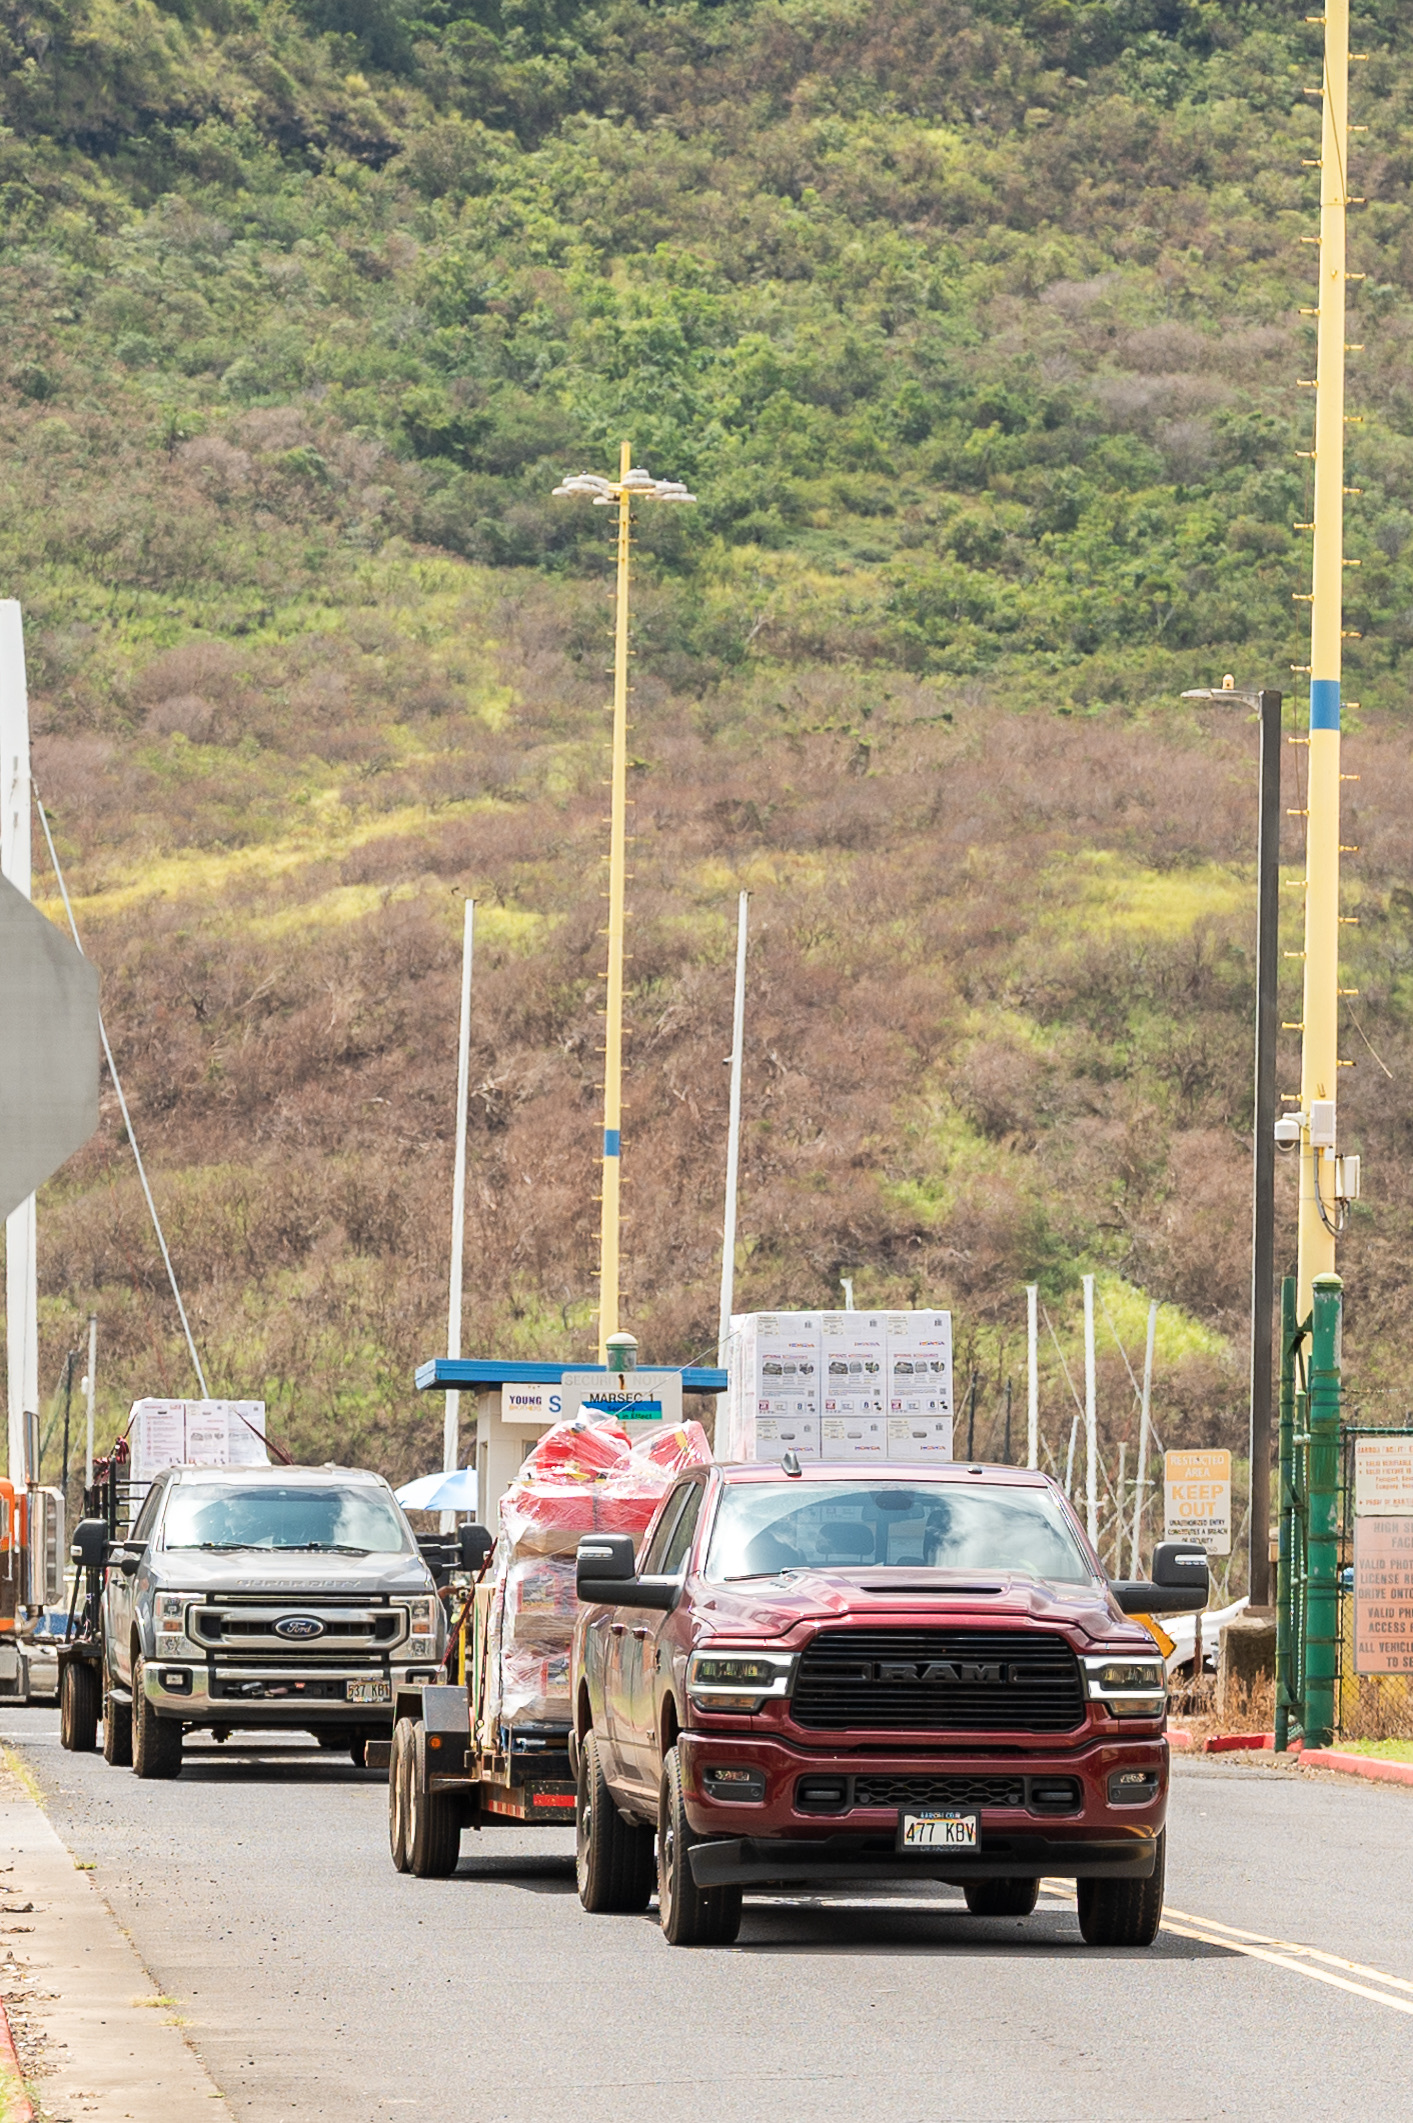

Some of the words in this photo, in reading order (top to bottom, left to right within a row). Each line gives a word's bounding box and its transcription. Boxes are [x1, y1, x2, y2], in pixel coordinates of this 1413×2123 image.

[565, 1375, 627, 1386] SECURIT
[509, 1395, 542, 1404] YOUNG
[589, 1393, 643, 1403] MARSEC
[1170, 1455, 1224, 1465] RESTRICTED
[1185, 1467, 1210, 1478] AREA
[1172, 1484, 1224, 1500] KEEP
[1179, 1501, 1216, 1517] OUT
[1373, 1521, 1399, 1533] HIGH
[1359, 1558, 1385, 1570] VALID
[237, 1579, 305, 1588] SUPER
[308, 1580, 361, 1588] DUTY
[1360, 1573, 1399, 1585] LICENSE
[1358, 1588, 1386, 1599] DRIVE
[1368, 1607, 1395, 1618] VALID
[286, 1621, 312, 1633] Ford
[1368, 1621, 1406, 1633] ACCESS
[1359, 1642, 1375, 1653] ALL
[1386, 1656, 1398, 1668] TO
[880, 1661, 1000, 1682] RAM
[906, 1823, 936, 1842] 477
[945, 1823, 975, 1842] KBV
